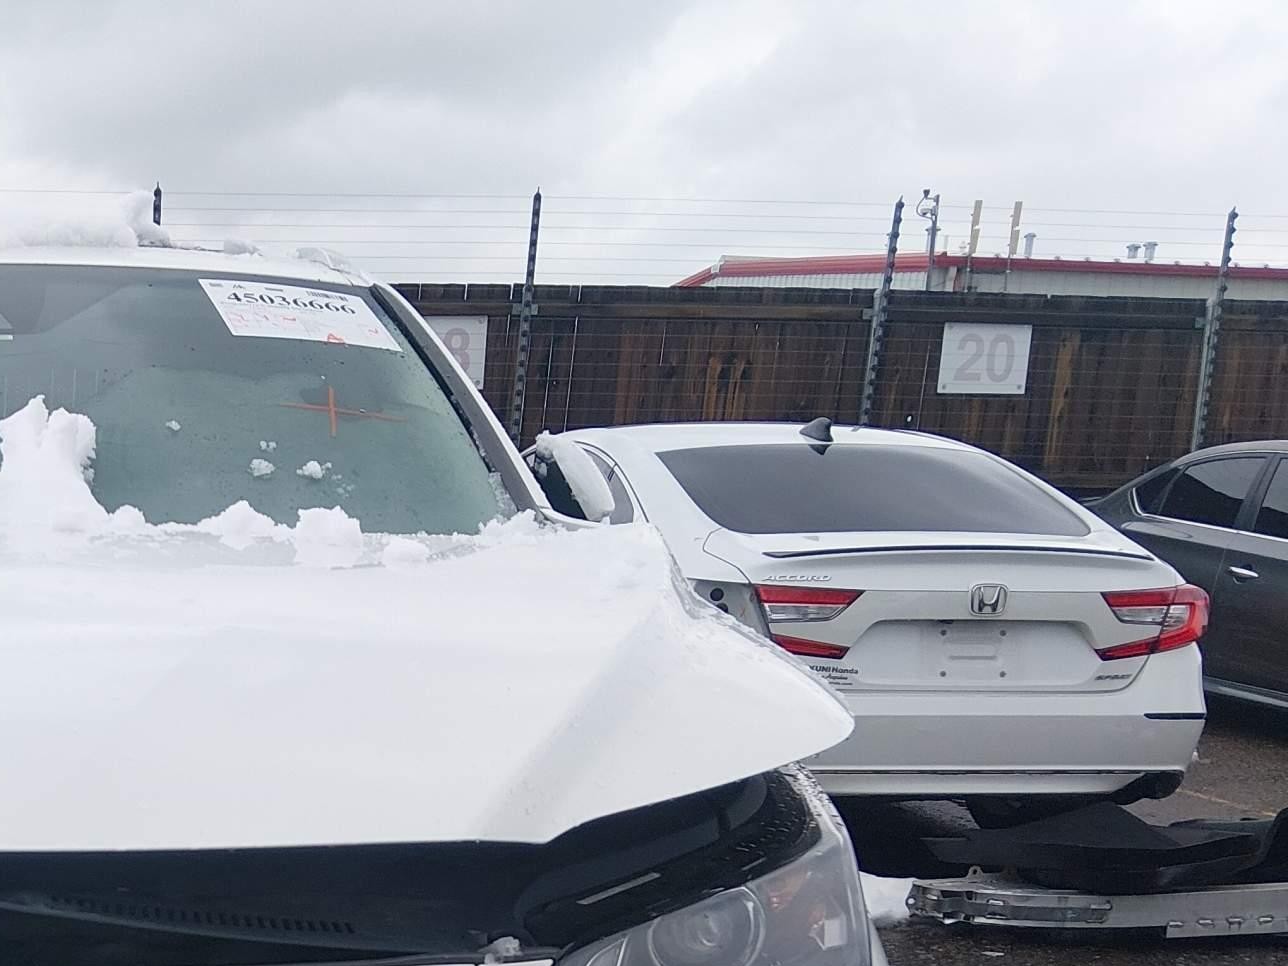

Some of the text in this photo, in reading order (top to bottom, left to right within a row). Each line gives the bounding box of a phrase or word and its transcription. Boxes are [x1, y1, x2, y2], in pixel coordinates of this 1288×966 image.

[227, 291, 356, 315] 45036666
[441, 327, 471, 372] 8
[953, 333, 1016, 383] 20
[762, 574, 833, 582] ACCORD
